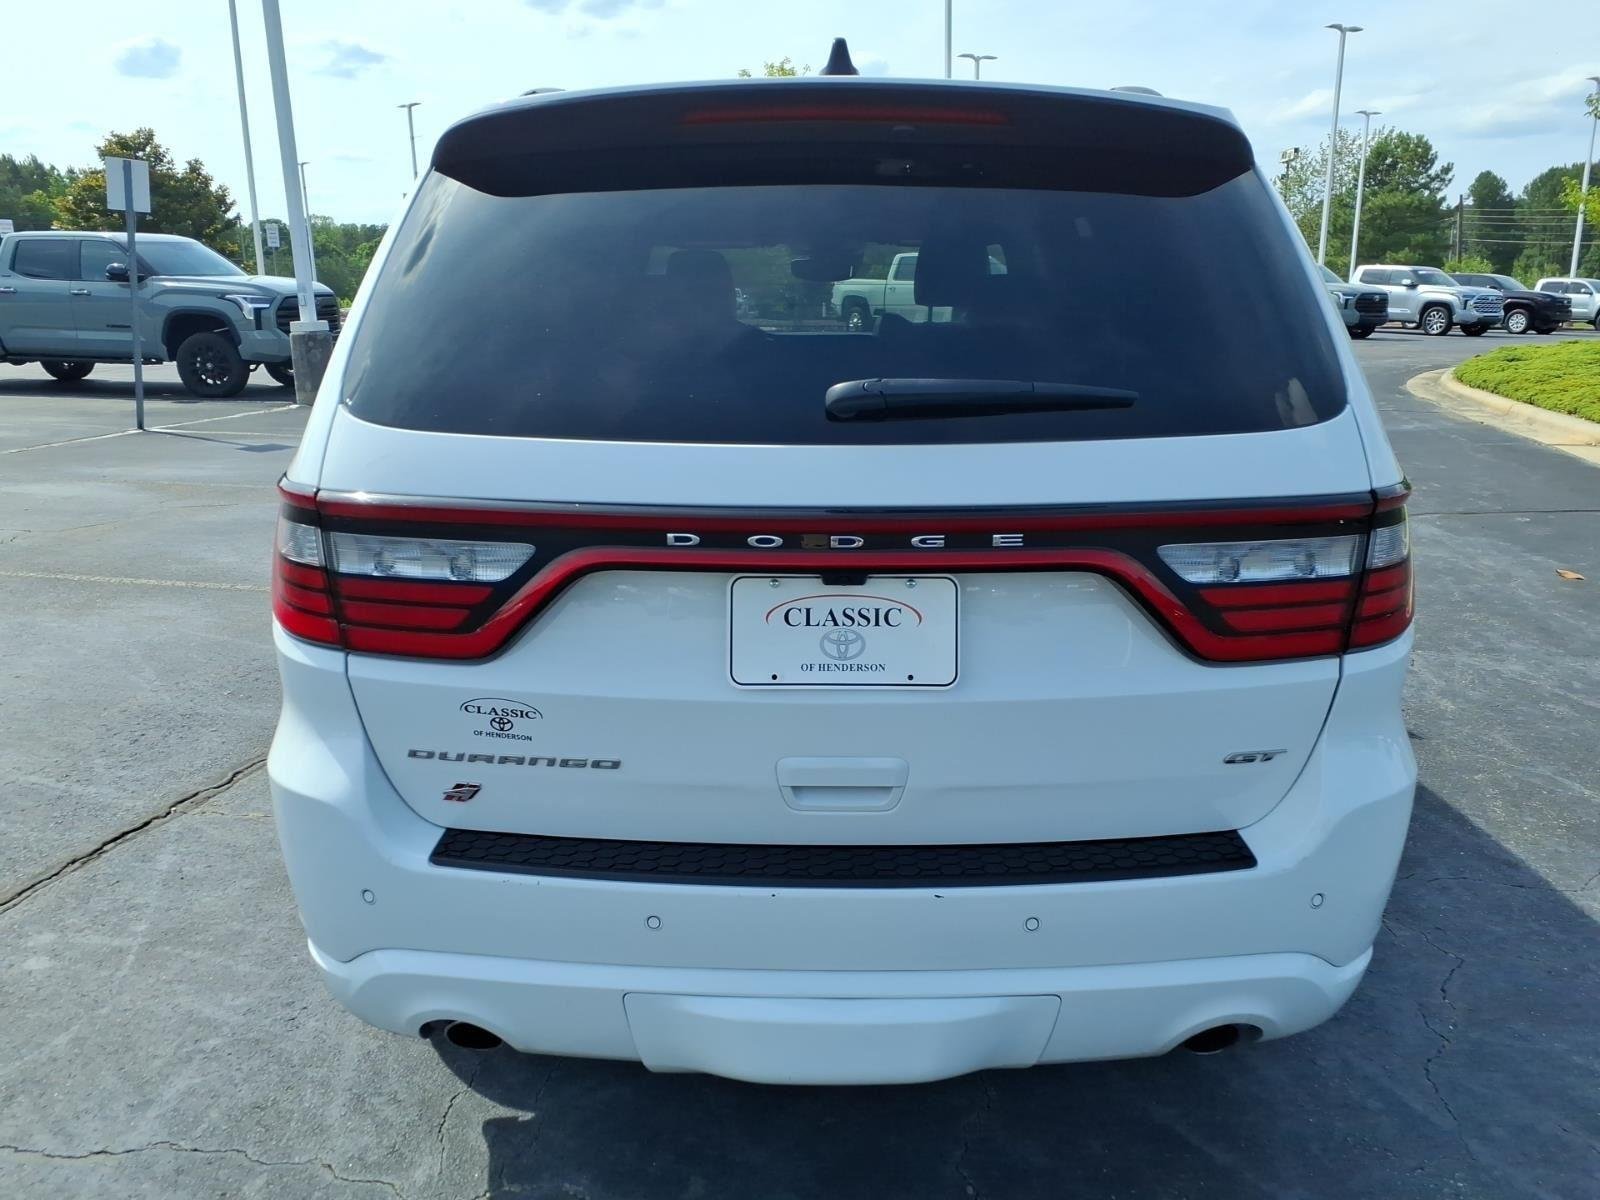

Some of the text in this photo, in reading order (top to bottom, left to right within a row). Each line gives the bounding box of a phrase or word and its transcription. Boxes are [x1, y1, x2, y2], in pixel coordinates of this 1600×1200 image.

[667, 533, 1024, 549] DODGE
[783, 606, 902, 628] CLASSIC
[800, 663, 886, 673] OF HENDERSON
[463, 704, 538, 720] CLASSIC
[473, 729, 533, 742] OF HENDERSON
[408, 748, 622, 770] DURANGO
[1223, 748, 1288, 764] GT
